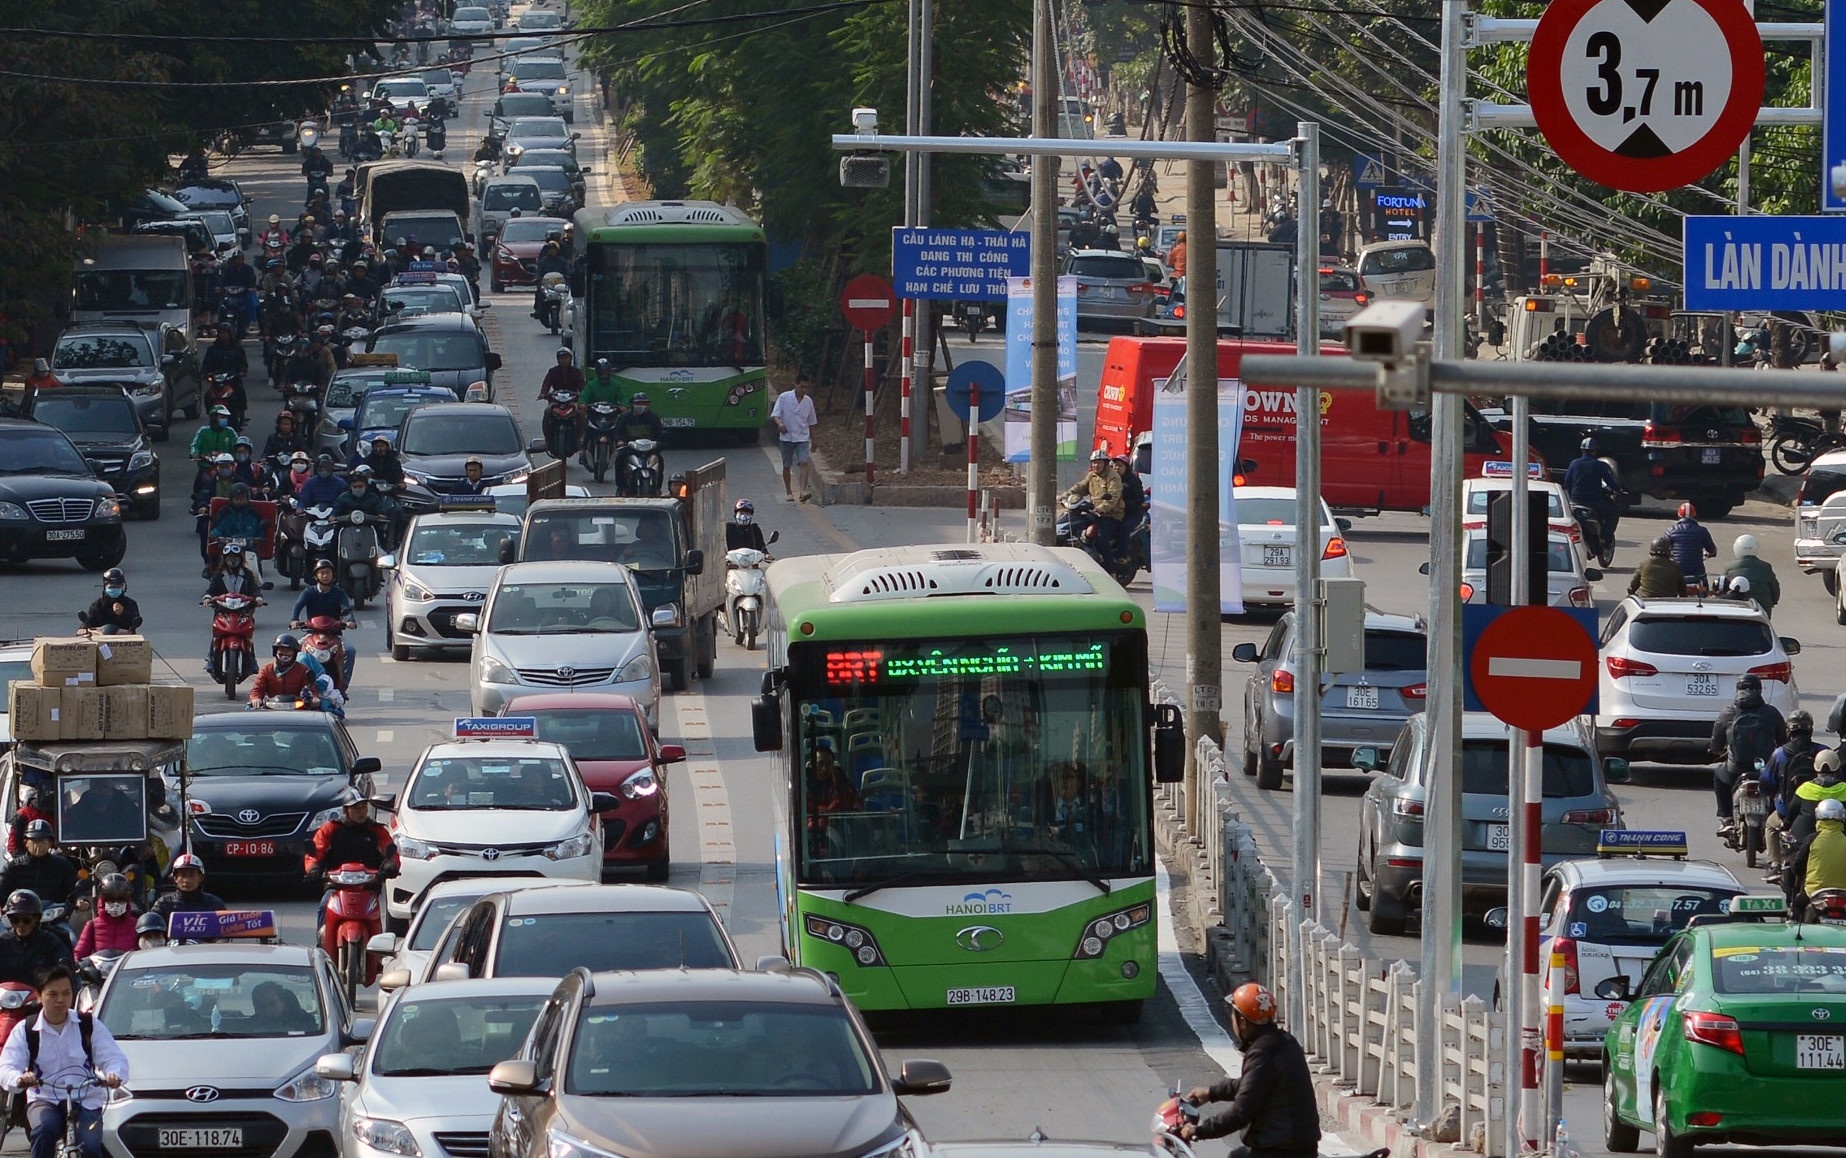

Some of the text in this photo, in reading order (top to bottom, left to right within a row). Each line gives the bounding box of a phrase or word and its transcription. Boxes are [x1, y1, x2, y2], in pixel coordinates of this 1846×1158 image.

[1674, 81, 1703, 116] m
[903, 231, 924, 245] CẦU
[929, 234, 957, 246] LÁNG
[961, 236, 975, 249] HẠ
[984, 235, 1007, 247] THÁI
[1012, 235, 1027, 248] HÀ
[921, 251, 1009, 263] ĐANG THI CÔNG
[1705, 231, 1846, 290] LÀN DÀNH
[916, 265, 937, 277] CÁC
[941, 267, 984, 278] PHƯƠNG
[906, 279, 1008, 295] HẠN CHẾ LƯU THÔ
[1250, 432, 1263, 440] The
[1264, 434, 1286, 442] power
[1694, 675, 1711, 683] 30A
[1355, 687, 1371, 696] 30E
[1349, 697, 1377, 707] 161.65
[466, 723, 531, 731] TAXIGROUP
[219, 915, 236, 924] Giá
[247, 919, 262, 929] Tốt
[948, 988, 1014, 1003] 29B-148.23
[1808, 1036, 1833, 1051] 30E
[1800, 1053, 1843, 1067] 111.44
[161, 1130, 240, 1146] 30E-118.74
